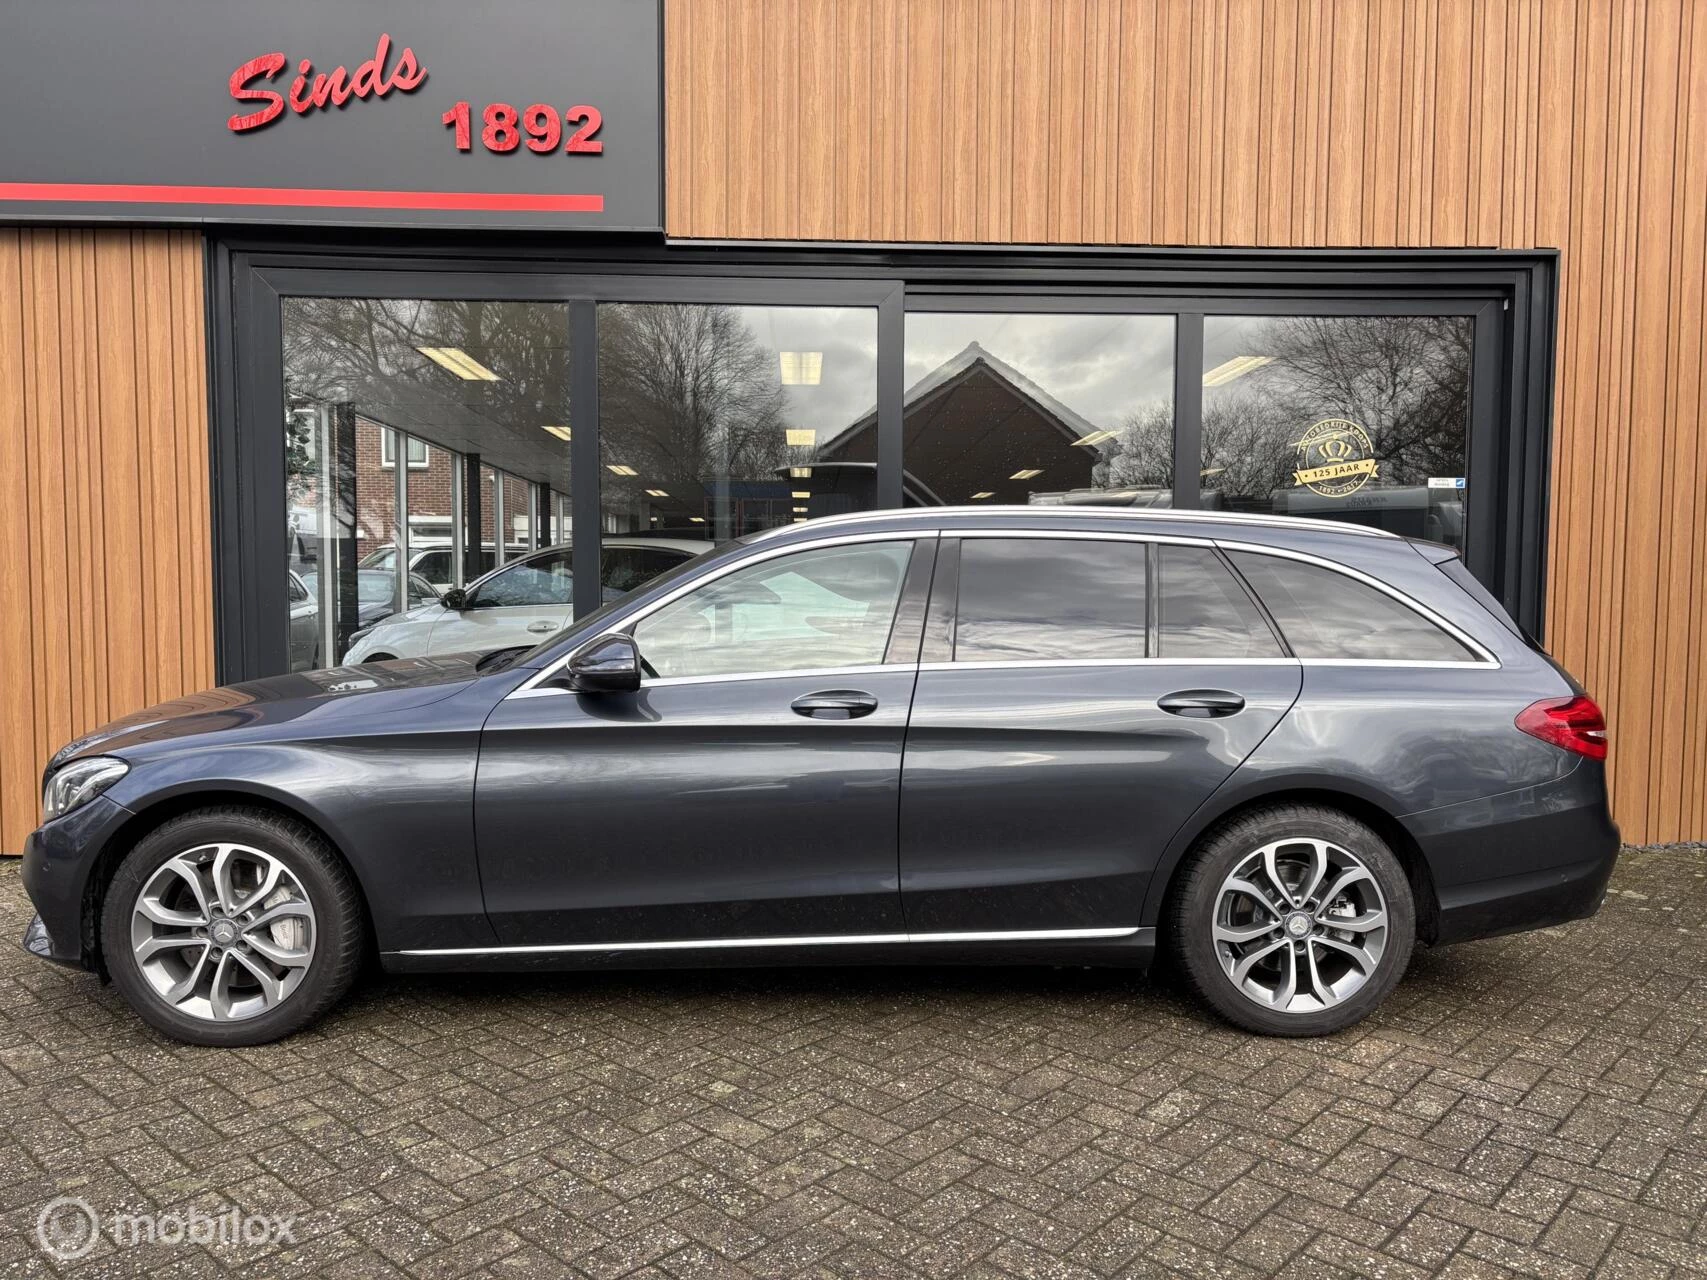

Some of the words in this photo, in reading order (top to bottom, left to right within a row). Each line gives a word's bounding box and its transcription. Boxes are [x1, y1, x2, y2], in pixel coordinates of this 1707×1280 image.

[227, 33, 427, 132] Sinds
[442, 101, 603, 153] 1892
[1313, 469, 1331, 478] 125
[1334, 463, 1360, 475] JAAR
